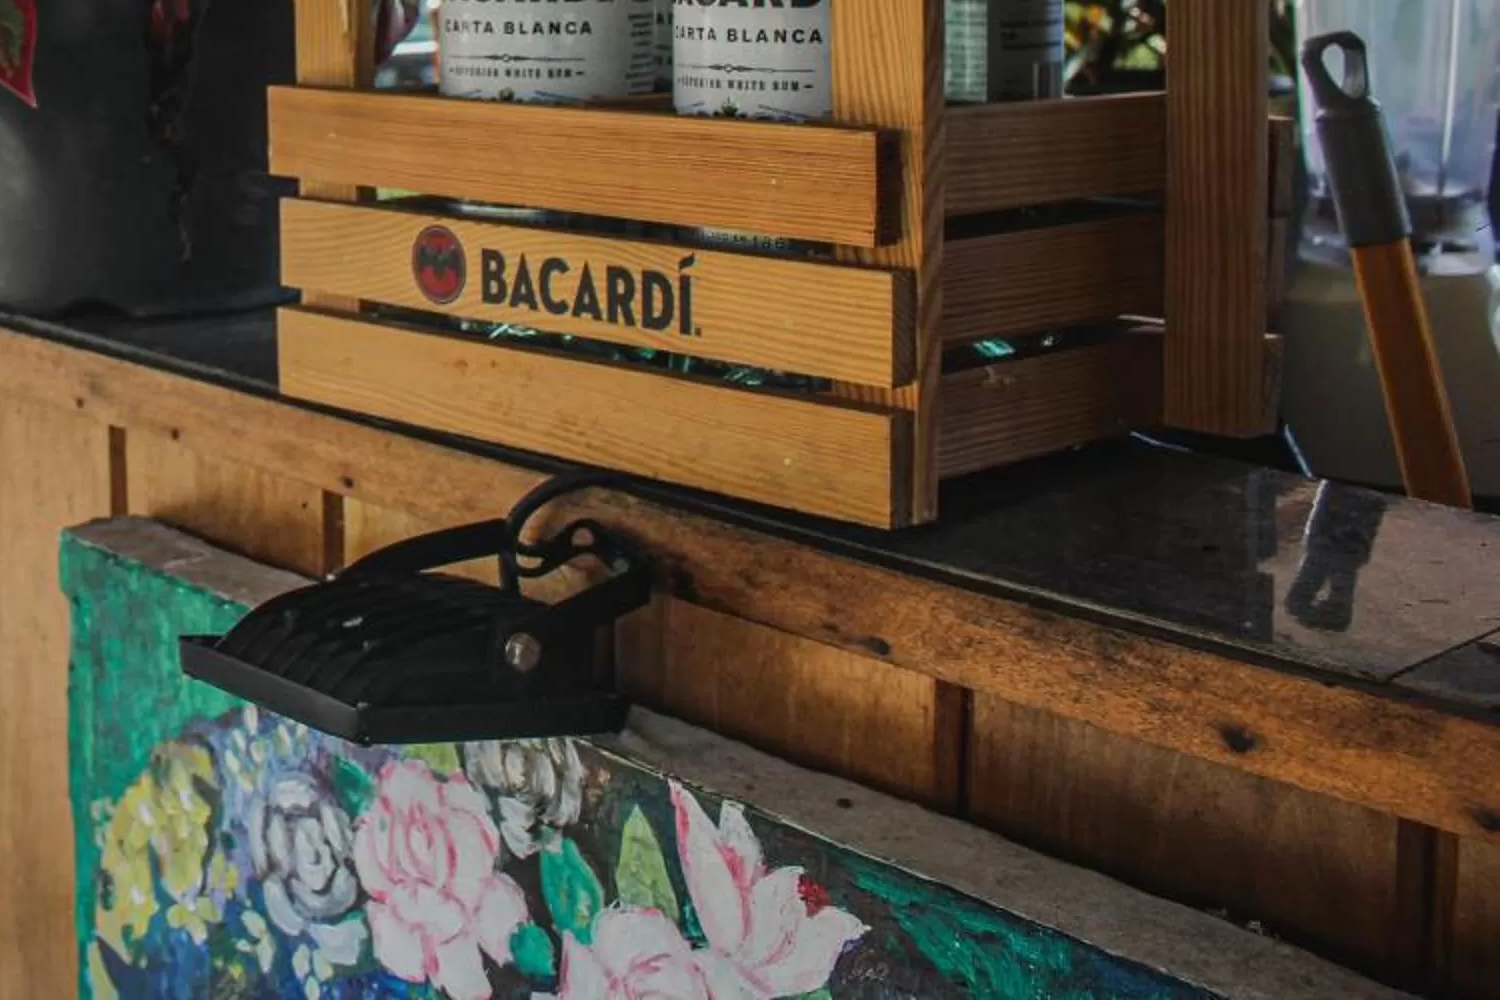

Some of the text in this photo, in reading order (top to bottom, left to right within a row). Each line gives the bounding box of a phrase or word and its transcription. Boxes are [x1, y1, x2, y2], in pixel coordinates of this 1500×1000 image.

[445, 19, 593, 36] CARTA BLANCA
[675, 26, 823, 44] CARTA BLANCA
[482, 248, 695, 337] BACARDÍ
